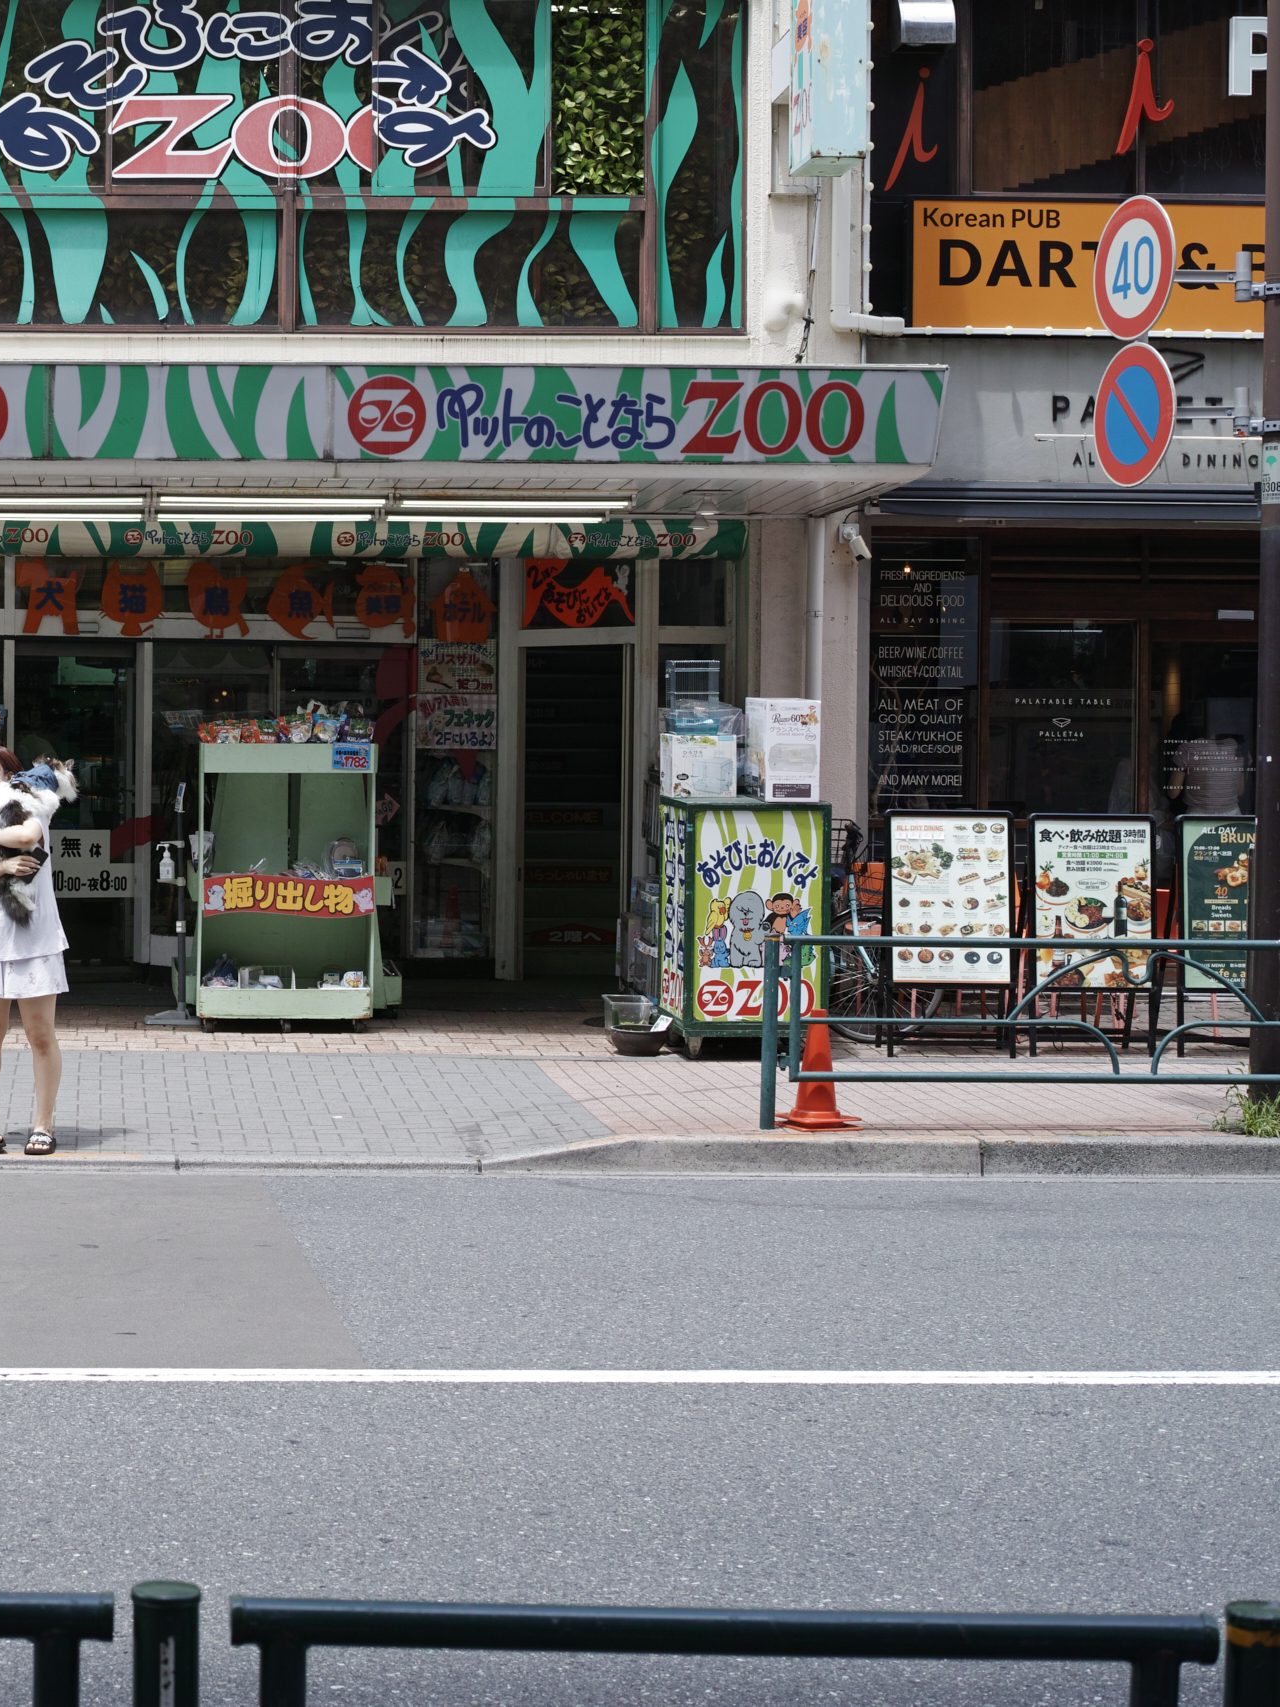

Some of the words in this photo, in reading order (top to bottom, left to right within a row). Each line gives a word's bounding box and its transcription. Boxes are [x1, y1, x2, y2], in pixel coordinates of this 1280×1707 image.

[108, 95, 373, 178] ZO
[923, 207, 1005, 228] Korean
[1012, 209, 1061, 228] PUB
[1112, 236, 1154, 300] 40
[437, 382, 675, 450] ペットのことなら
[681, 380, 866, 456] ZOO
[1182, 454, 1258, 467] DINING
[5, 528, 48, 543] ZOO
[145, 530, 209, 545] ペットのことなら
[212, 529, 253, 546] ZOO
[356, 533, 420, 547] ペットのことなら
[423, 532, 465, 547] ZOO
[588, 533, 652, 548] ペットのことなら
[655, 533, 697, 547] ZOO
[880, 570, 908, 581] FRESH
[911, 570, 965, 581] INGREDIENTS
[367, 582, 396, 593] ペット
[913, 583, 932, 593] AND
[36, 581, 64, 612] 犬
[120, 585, 147, 614] 猫
[205, 588, 229, 615] 鳥
[449, 590, 477, 601] ペット
[880, 595, 933, 607] DELICIOUS
[936, 595, 964, 607] FOOD
[288, 590, 314, 618] 魚
[365, 594, 401, 615] 美容
[442, 602, 486, 623] ホテル
[435, 654, 479, 666] リスザル
[878, 646, 964, 659] BEER/WINE/COFFEE
[878, 665, 963, 678] WHISKEY/COCKTAIL
[878, 699, 899, 711] ALL
[903, 699, 939, 711] MEAT
[945, 699, 964, 711] OF
[1080, 698, 1111, 706] TABLE
[444, 708, 495, 728] フェネック
[878, 714, 915, 724] GOOD
[920, 713, 963, 725] QUALITY
[878, 730, 963, 742] STEAK/YUKHOE
[878, 744, 963, 755] SALAD/RICE/SOUP
[878, 774, 899, 786] AND
[901, 774, 929, 786] MANY
[931, 774, 963, 786] MORE!
[1039, 828, 1122, 843] 食べ・飲み放題
[1123, 829, 1146, 839] 3時間
[696, 839, 818, 889] あそびにおいでよ
[223, 877, 355, 914] 掘り出し物
[1214, 886, 1229, 897] 40
[549, 930, 602, 943] 2階へ
